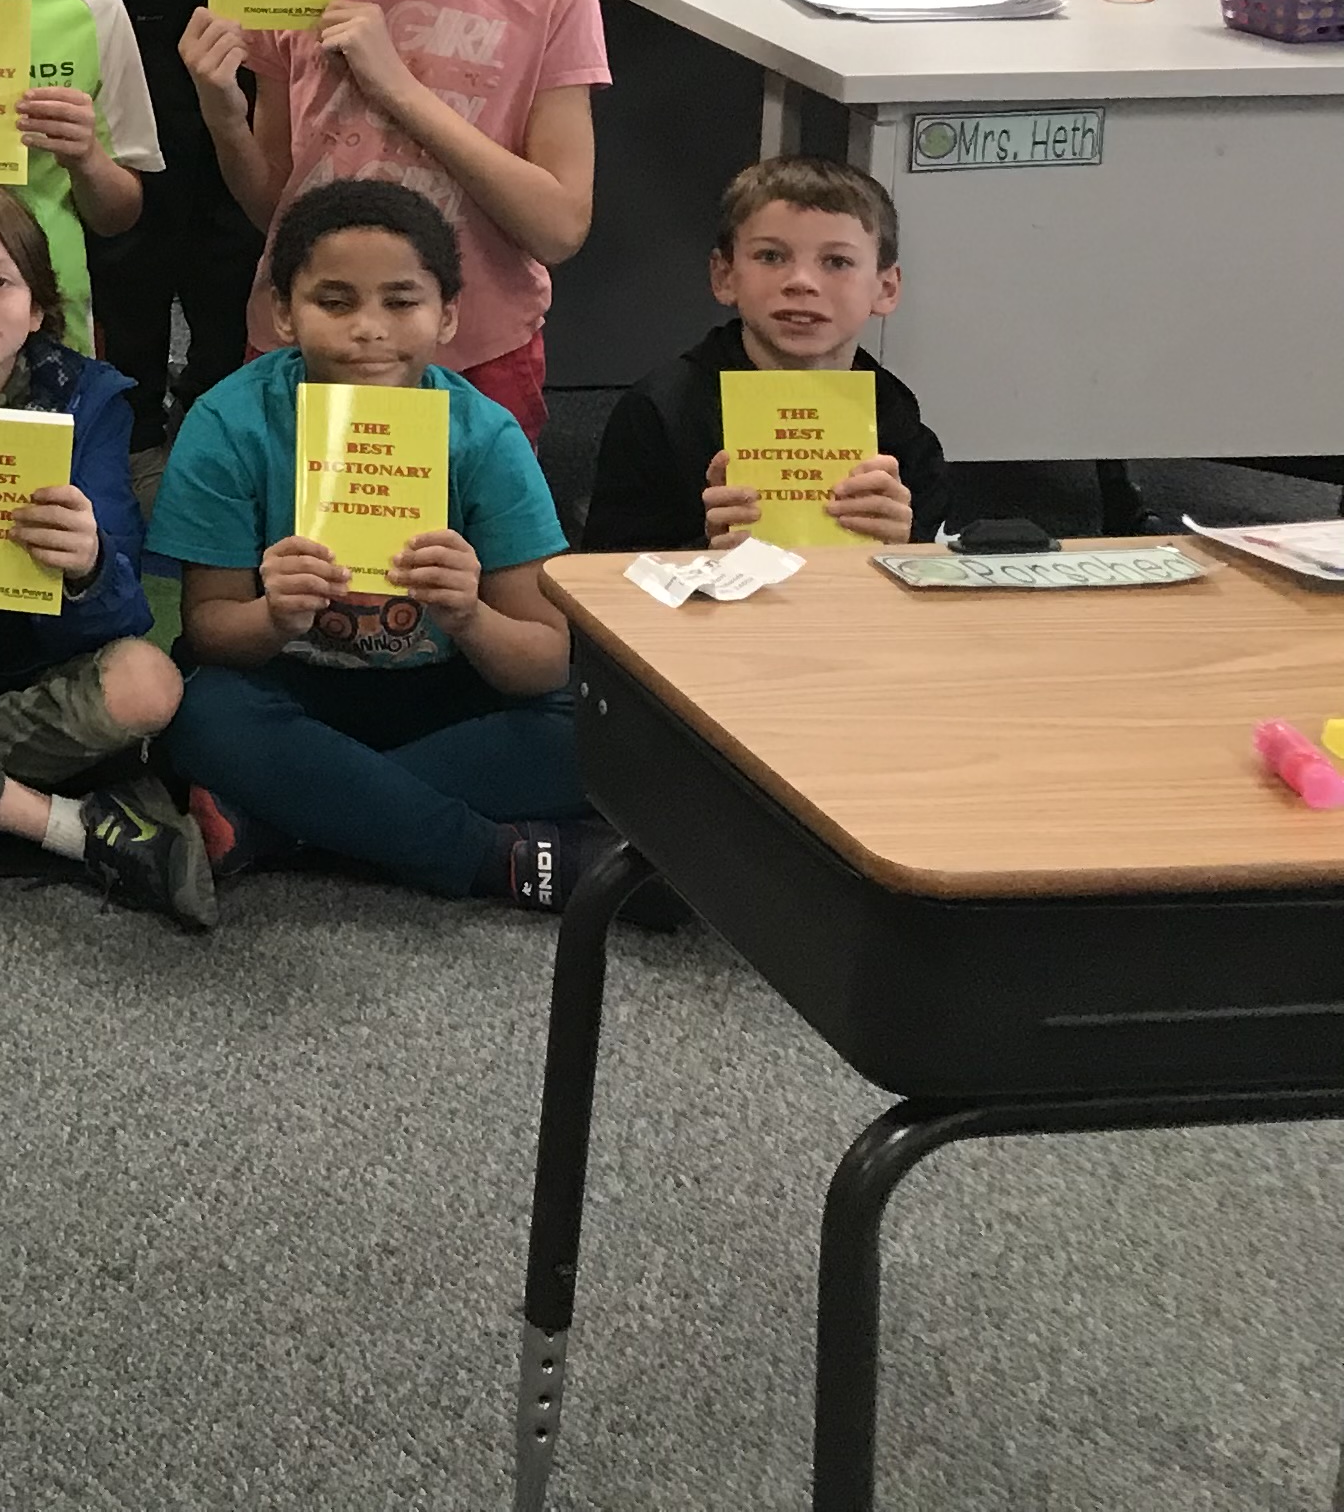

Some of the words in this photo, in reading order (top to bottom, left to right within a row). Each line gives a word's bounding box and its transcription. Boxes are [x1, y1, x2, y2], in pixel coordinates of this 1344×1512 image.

[957, 120, 1019, 160] Mrs.
[1031, 118, 1098, 159] Heth
[350, 422, 390, 435] THE
[346, 442, 395, 456] BEST
[307, 460, 432, 479] DICTIONARY
[349, 484, 390, 496] FOR
[317, 502, 421, 519] STUDENTS
